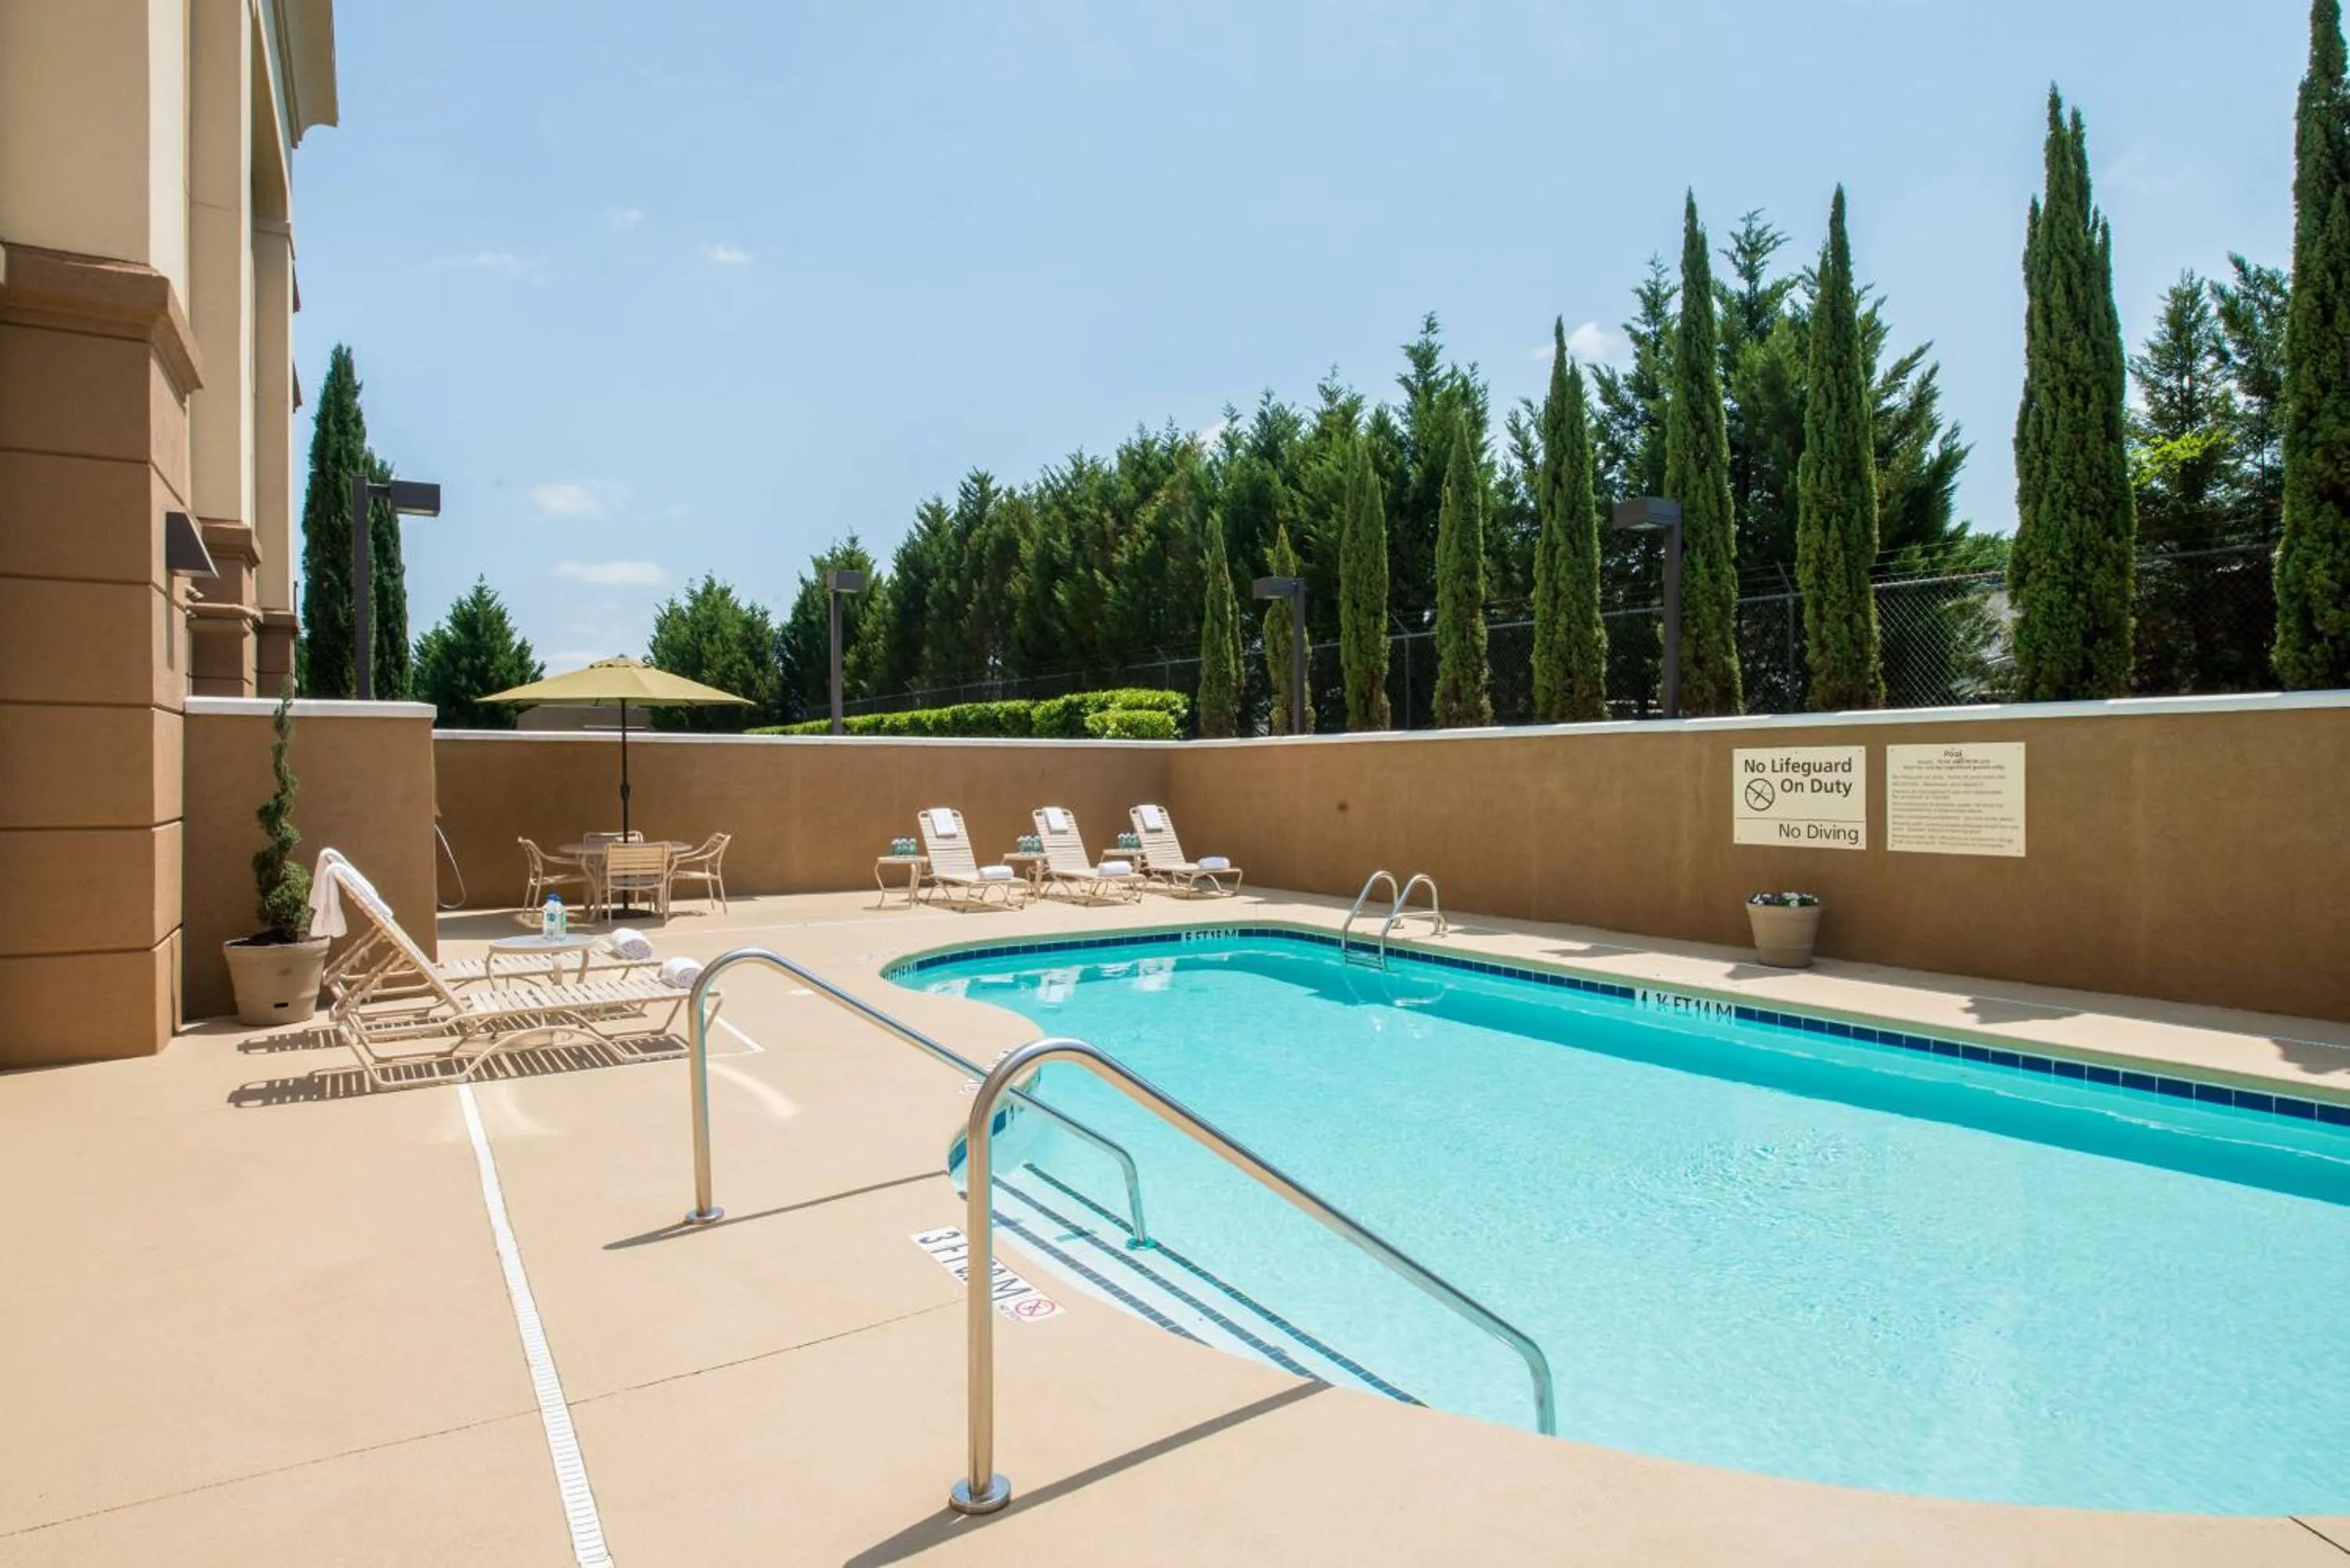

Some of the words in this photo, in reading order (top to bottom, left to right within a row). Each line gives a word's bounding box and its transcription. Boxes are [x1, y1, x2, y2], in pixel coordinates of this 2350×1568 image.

[1744, 759, 1766, 773] No
[1771, 757, 1852, 777] Lifeguard
[1781, 779, 1805, 793] On
[1810, 779, 1853, 797] Duty
[1779, 824, 1801, 838] No
[1807, 824, 1859, 845] Diving
